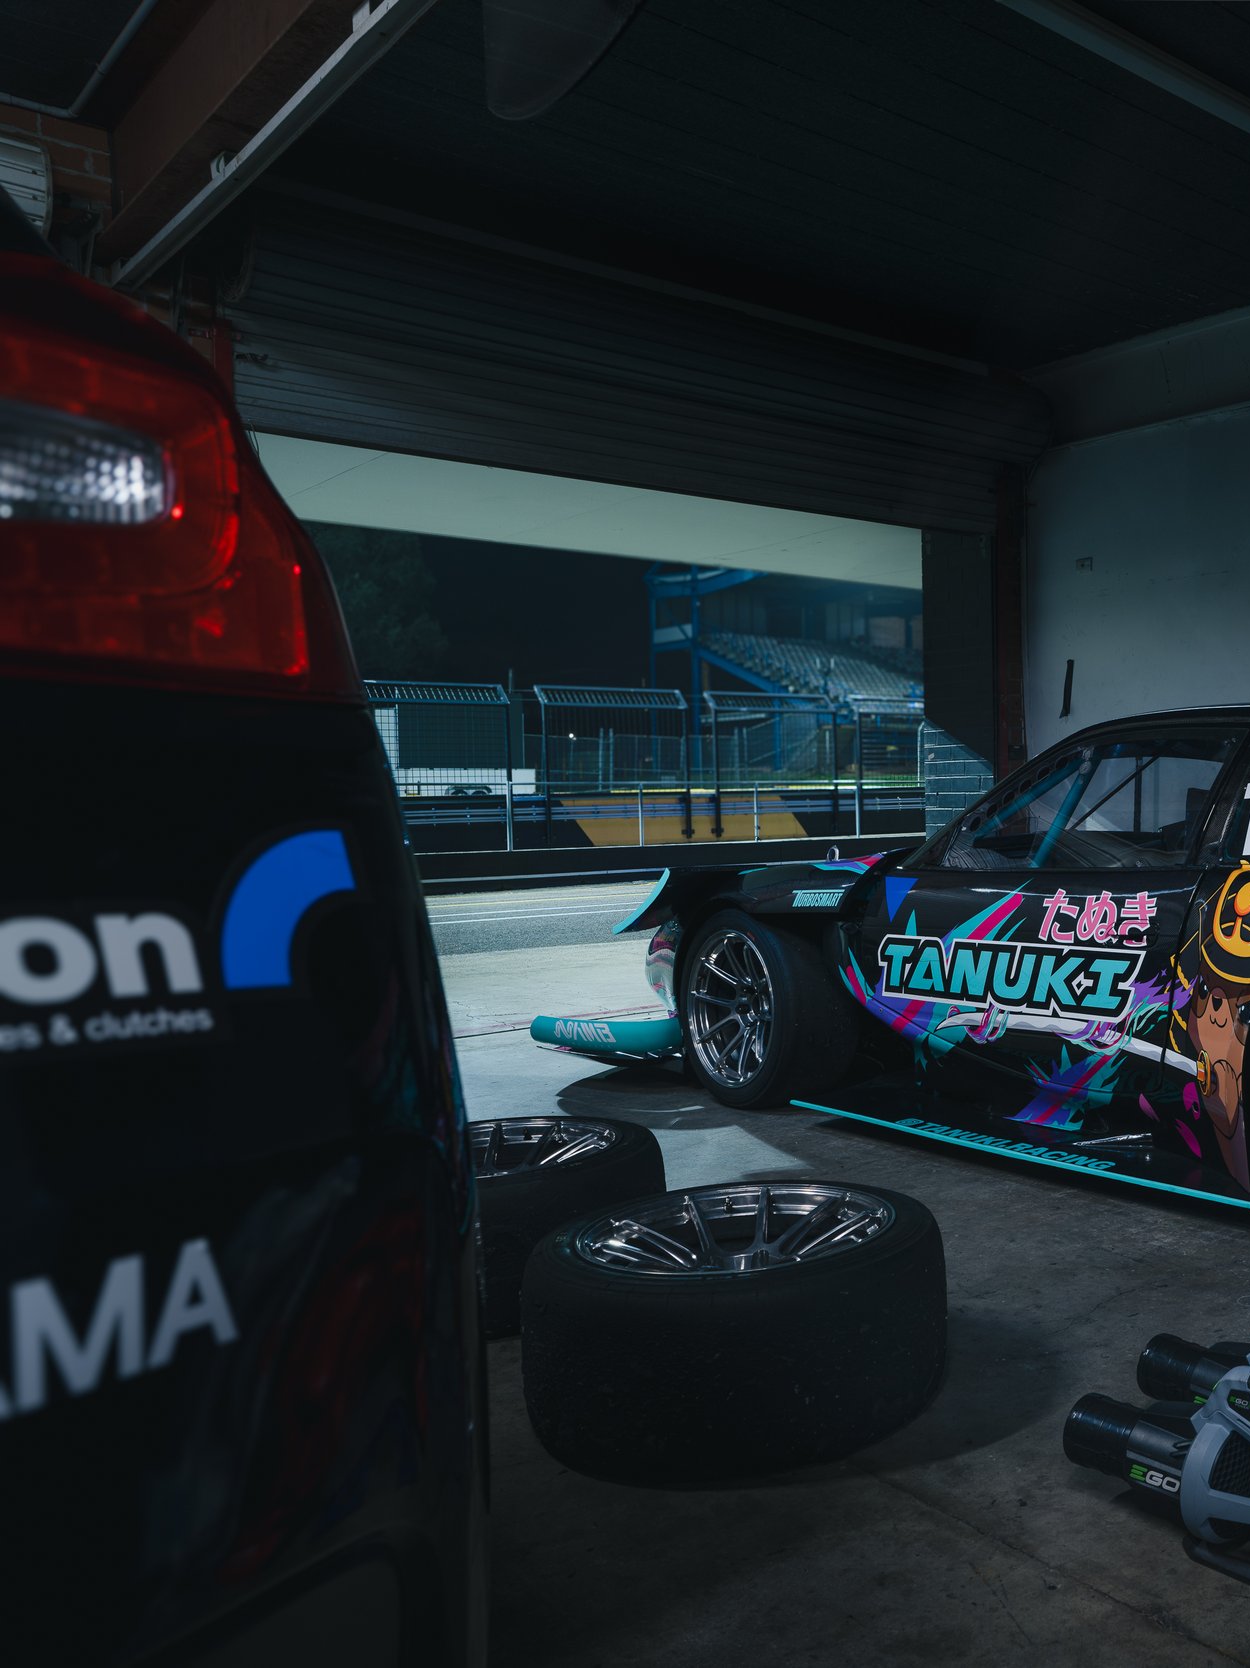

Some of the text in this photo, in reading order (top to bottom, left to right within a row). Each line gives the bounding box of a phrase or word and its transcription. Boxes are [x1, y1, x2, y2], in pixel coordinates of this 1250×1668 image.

[792, 889, 846, 908] TURBOSMART
[1038, 888, 1158, 948] たぬき
[881, 942, 1134, 1013] TANUKI
[48, 1012, 80, 1046] &
[83, 1004, 215, 1042] clutches
[0, 1234, 241, 1424] MA
[1128, 1463, 1181, 1493] EGO
